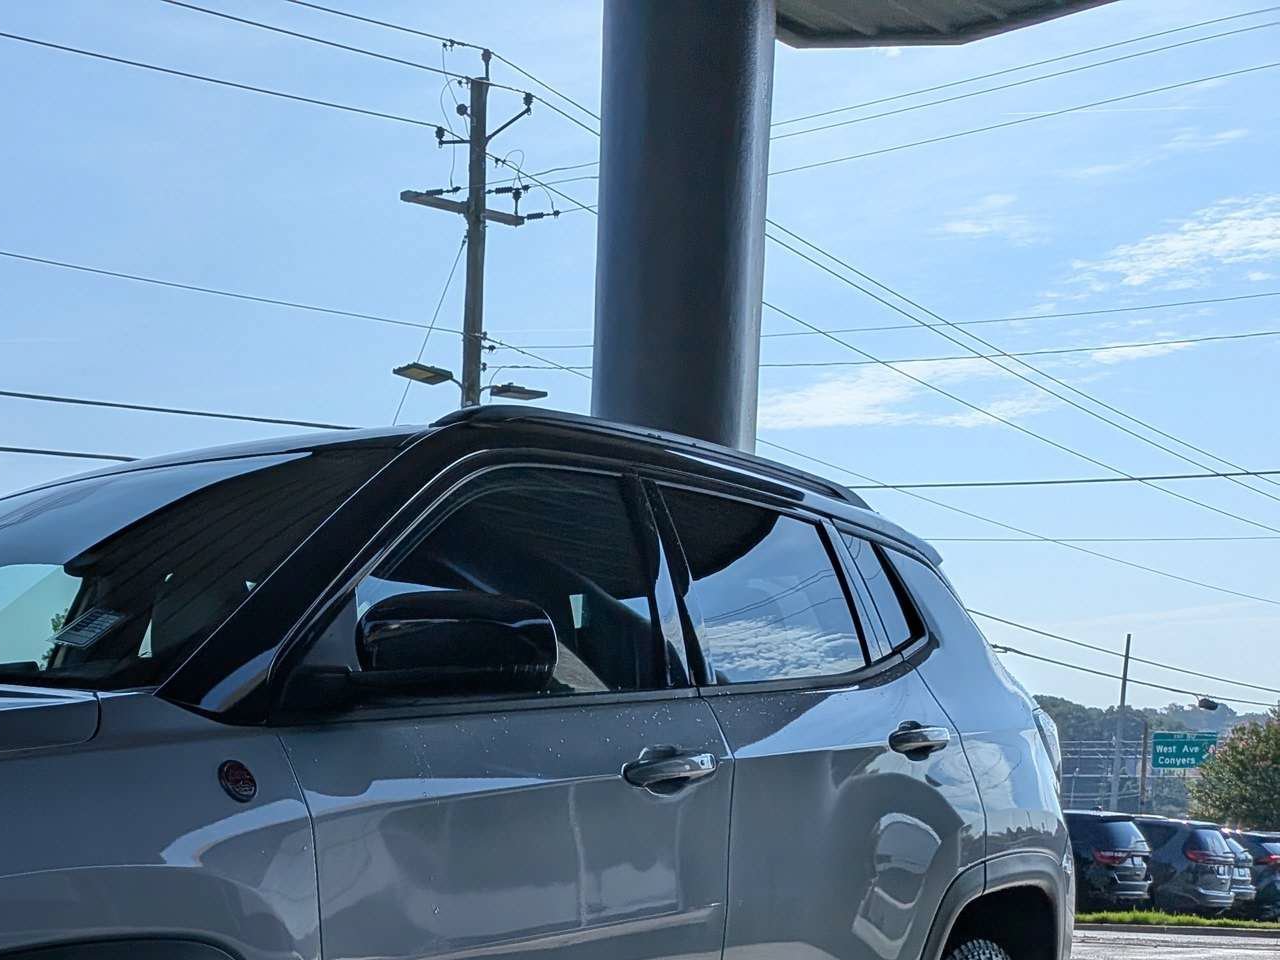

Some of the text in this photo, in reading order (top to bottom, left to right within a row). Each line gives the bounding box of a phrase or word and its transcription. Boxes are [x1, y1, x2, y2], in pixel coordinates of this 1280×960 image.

[1156, 745, 1200, 753] West Ave
[1158, 756, 1196, 766] Conyers
